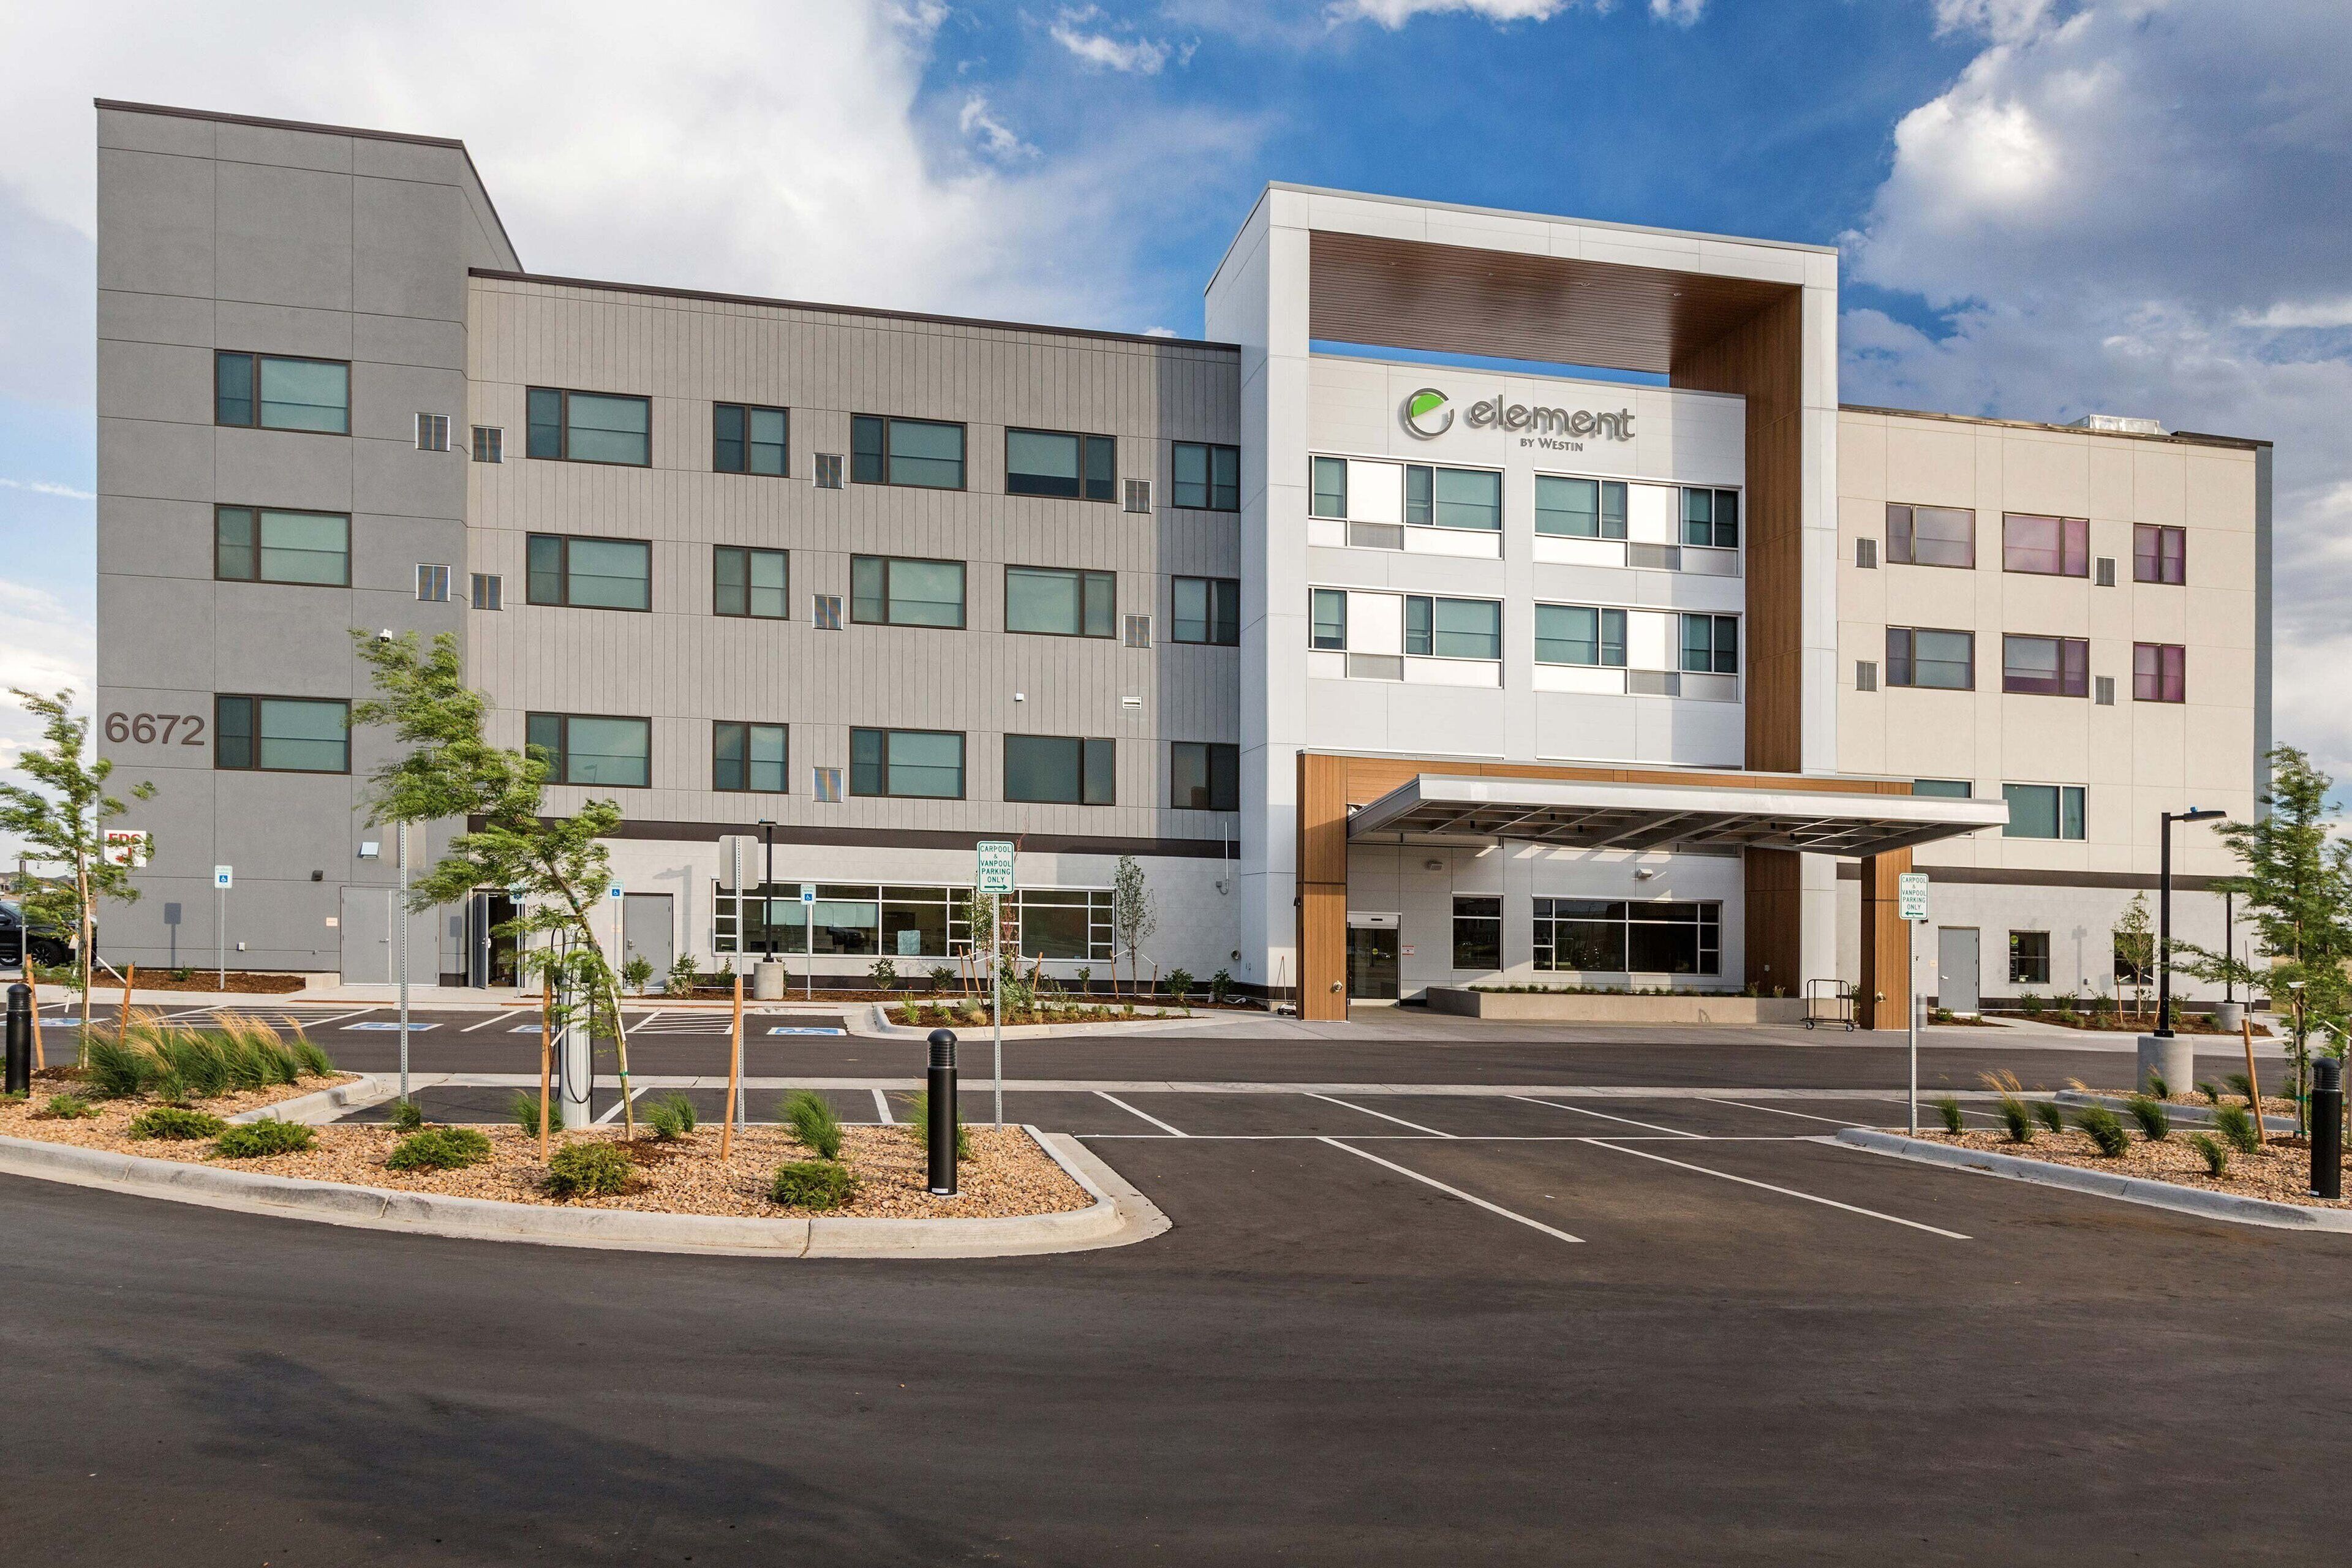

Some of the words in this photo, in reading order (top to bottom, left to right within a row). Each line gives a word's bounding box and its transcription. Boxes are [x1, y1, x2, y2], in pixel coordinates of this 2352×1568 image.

[1471, 394, 1635, 437] element
[1520, 438, 1535, 448] BY
[105, 712, 205, 746] 6672
